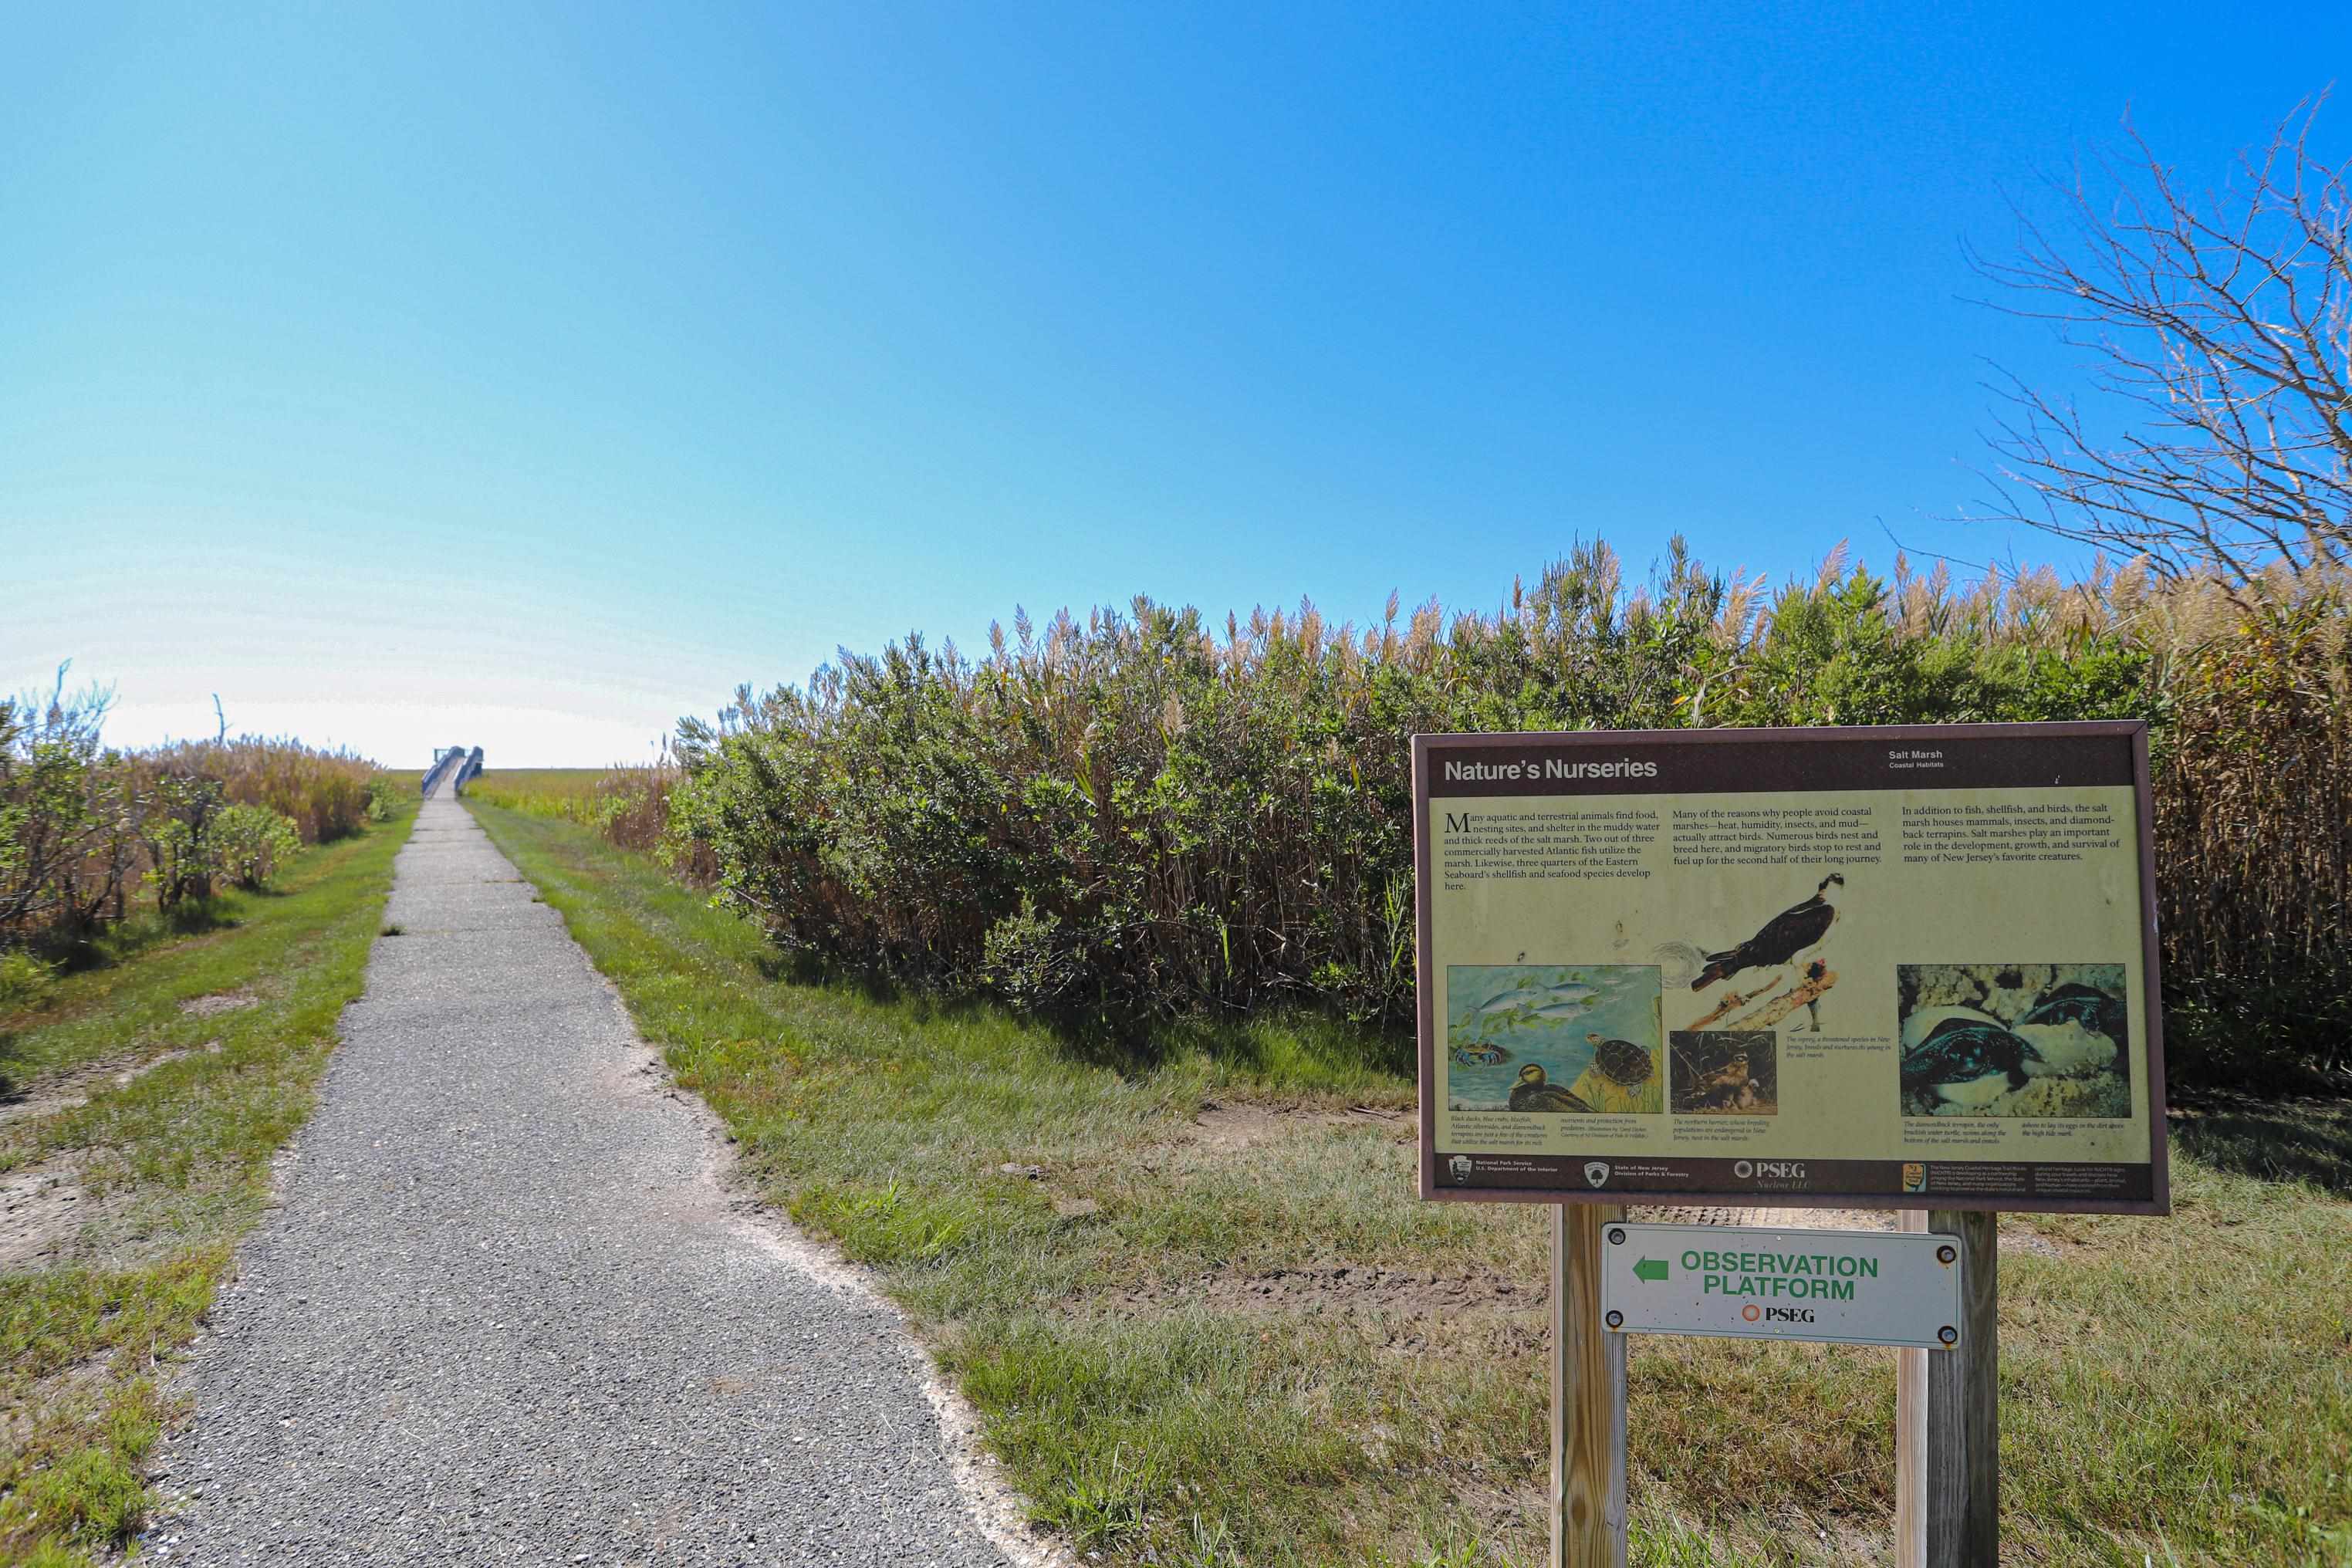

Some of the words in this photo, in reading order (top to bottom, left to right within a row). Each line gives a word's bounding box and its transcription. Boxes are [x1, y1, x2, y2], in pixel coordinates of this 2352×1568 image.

[1911, 749, 1941, 759] Marsh
[1445, 759, 1539, 780] Nature's
[1546, 758, 1657, 778] Nurseries
[1673, 810, 1697, 820] Many
[1762, 809, 1779, 819] why
[1783, 808, 1812, 819] people
[1815, 807, 1838, 816] avoid
[1902, 806, 1911, 815] In
[1914, 806, 1951, 815] addition
[1965, 806, 1983, 814] fish,
[1986, 805, 2025, 813] shellfish,
[2047, 804, 2073, 815] birds,
[2075, 804, 2090, 813] the
[1486, 814, 1517, 823] aquatic
[1537, 811, 1578, 820] terrestrial
[1580, 811, 1614, 819] animals
[1616, 810, 1633, 821] find
[1634, 810, 1658, 820] food,
[1903, 818, 1930, 826] marsh
[1932, 817, 1963, 826] houses
[1966, 816, 2011, 826] mammals,
[2014, 817, 2047, 826] insects,
[2050, 816, 2066, 824] and
[1505, 824, 1526, 833] sites,
[1528, 823, 1543, 832] and
[1577, 823, 1585, 831] in
[1603, 822, 1634, 833] muddy
[1635, 823, 1660, 832] water
[1742, 820, 1782, 830] humidity,
[1785, 820, 1816, 829] insects,
[1819, 819, 1835, 827] and
[1445, 836, 1459, 844] and
[1462, 836, 1482, 844] thick
[1509, 835, 1519, 843] of
[1521, 835, 1534, 843] the
[1583, 834, 1602, 843] Two
[1620, 833, 1630, 842] of
[1632, 833, 1654, 843] three
[1673, 833, 1705, 843] actually
[1739, 832, 1762, 840] birds.
[1766, 831, 1813, 840] Numerous
[1816, 831, 1838, 840] birds
[1861, 830, 1877, 839] and
[1903, 830, 1924, 838] back
[1926, 829, 1968, 840] terrapins.
[1971, 829, 1987, 837] Salt
[1989, 828, 2026, 837] marshes
[2029, 828, 2048, 839] play
[2063, 828, 2109, 838] important
[1673, 844, 1698, 853] breed
[1701, 844, 1722, 853] here,
[1744, 844, 1786, 854] migratory
[1788, 843, 1810, 851] birds
[1813, 844, 1832, 853] stop
[1864, 842, 1881, 850] and
[1904, 842, 1921, 850] role
[1935, 841, 1948, 850] the
[1951, 840, 2012, 852] development,
[2014, 840, 2050, 850] growth,
[2052, 840, 2070, 848] and
[2072, 839, 2107, 849] survival
[2110, 839, 2120, 847] of
[1445, 847, 1501, 857] commercially
[1503, 847, 1543, 855] harvested
[1931, 853, 1940, 861] of
[1943, 853, 1964, 861] New
[1965, 853, 1999, 863] Jersey's
[2002, 852, 2036, 860] favorite
[1445, 859, 1472, 867] marsh.
[1540, 858, 1576, 868] quarters
[1692, 858, 1703, 867] up
[1706, 856, 1718, 864] for
[1737, 855, 1767, 863] second
[1770, 855, 1787, 863] half
[1801, 854, 1821, 863] their
[1824, 854, 1844, 864] long
[1846, 854, 1881, 864] journey.
[1547, 869, 1580, 877] seafood
[1583, 869, 1614, 880] species
[1616, 869, 1650, 879] develop
[1756, 1162, 1804, 1178] PSEG
[1681, 1250, 1877, 1278] OBSERVATION
[1704, 1275, 1854, 1300] PLATFORM
[1766, 1307, 1813, 1322] PSEG
